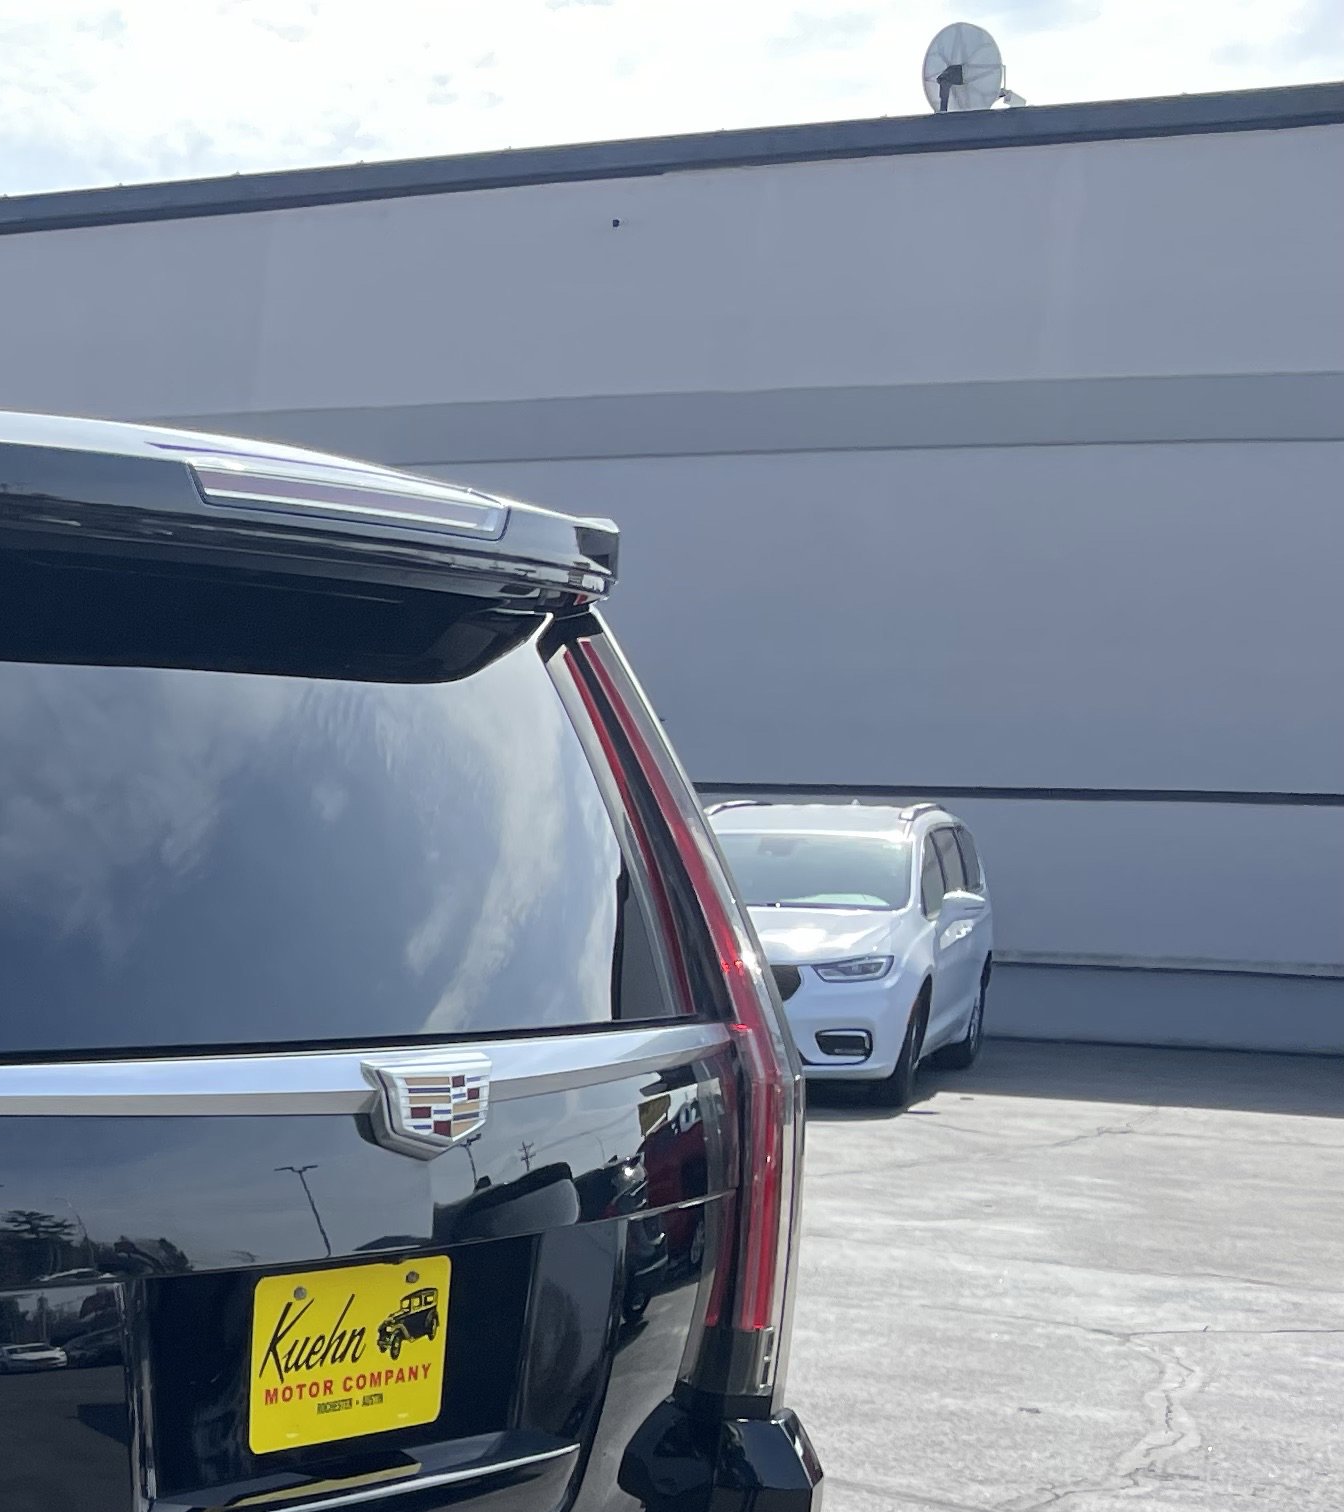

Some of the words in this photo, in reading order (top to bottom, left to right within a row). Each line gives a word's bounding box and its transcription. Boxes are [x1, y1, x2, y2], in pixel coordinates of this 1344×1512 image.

[259, 1293, 366, 1384] Kuehn
[264, 1380, 333, 1405] MOTOR
[343, 1363, 431, 1392] COMPANY
